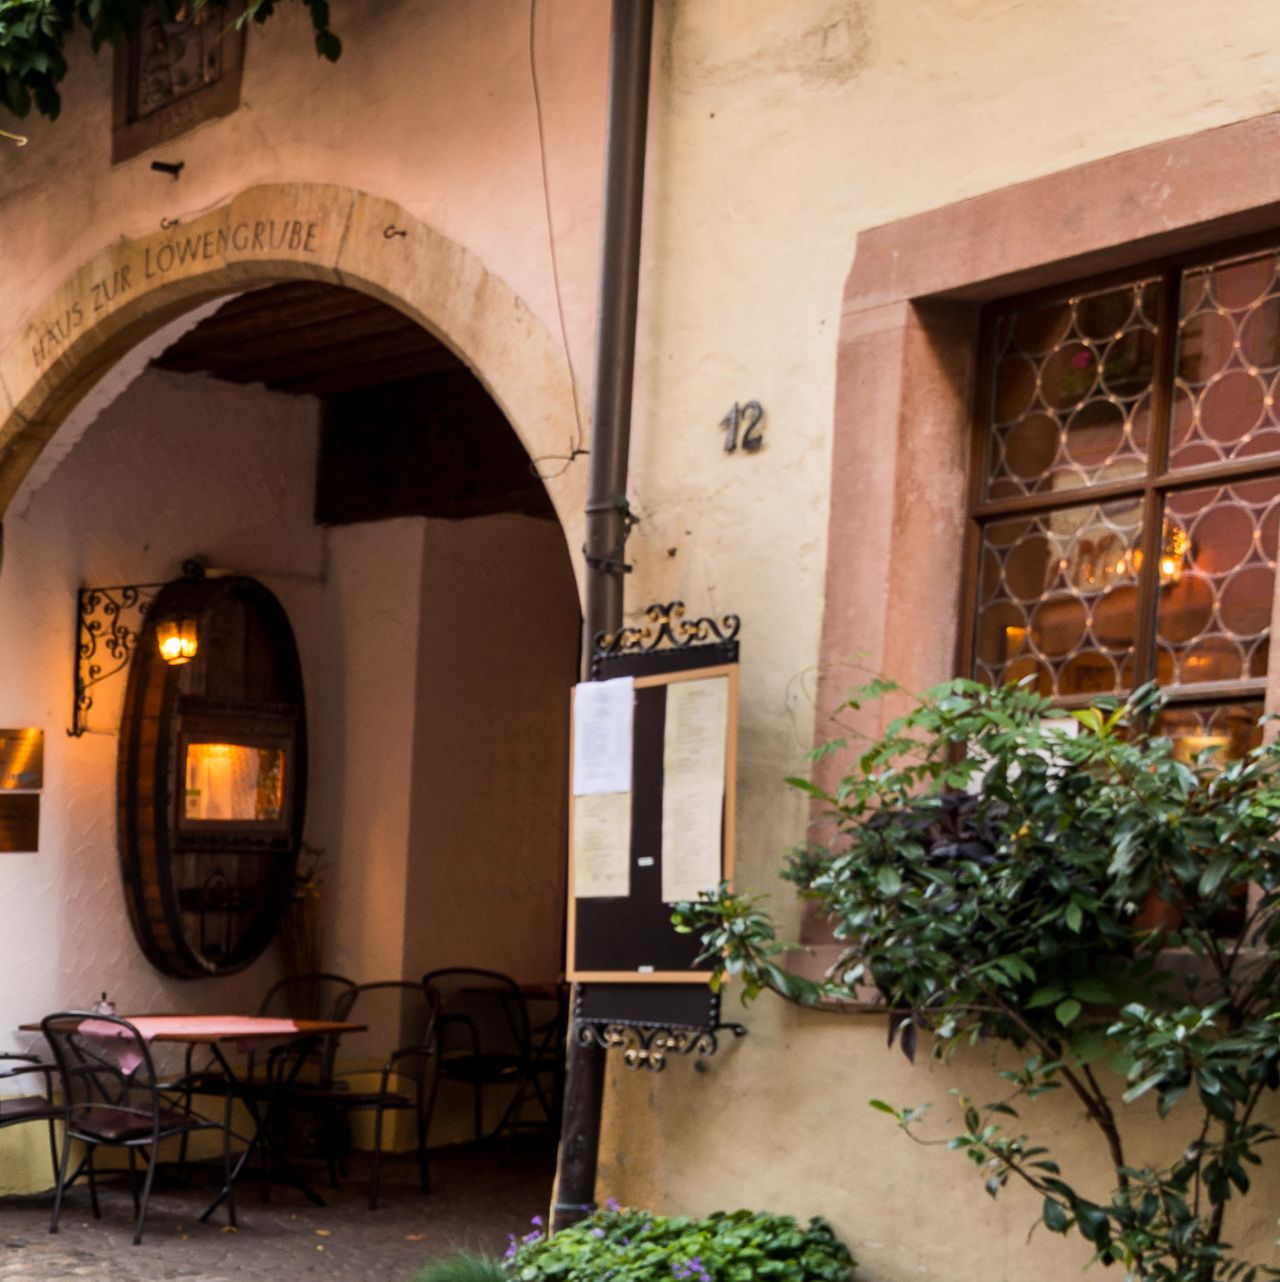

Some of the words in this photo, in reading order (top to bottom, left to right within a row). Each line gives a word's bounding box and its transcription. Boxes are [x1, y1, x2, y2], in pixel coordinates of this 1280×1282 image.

[31, 302, 84, 367] HAUS
[90, 265, 131, 312] ZUR
[143, 220, 319, 279] LÖWENGRUBE
[719, 400, 763, 453] 12
